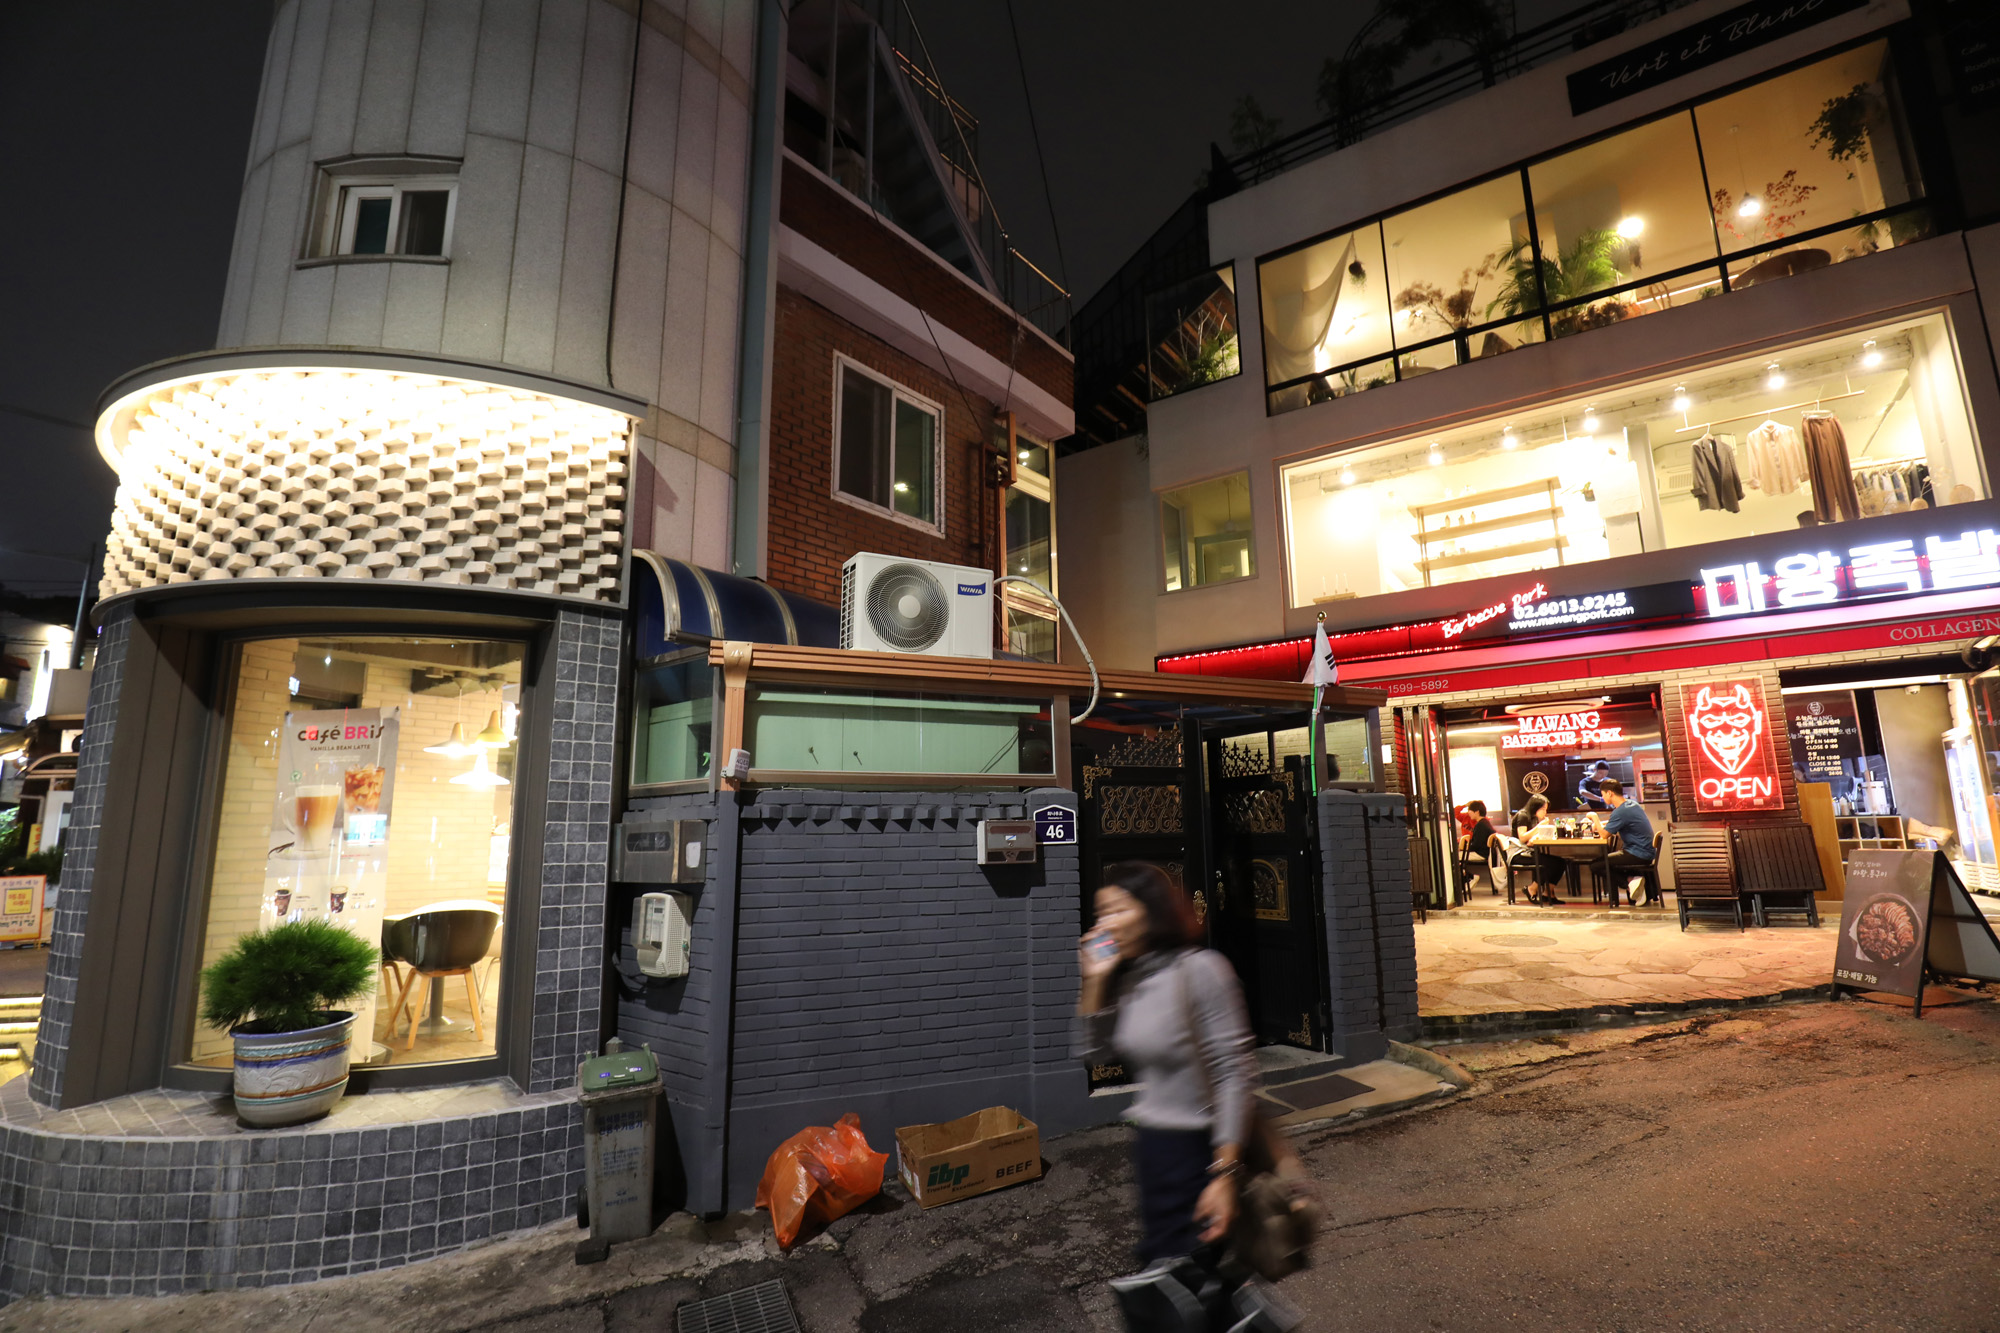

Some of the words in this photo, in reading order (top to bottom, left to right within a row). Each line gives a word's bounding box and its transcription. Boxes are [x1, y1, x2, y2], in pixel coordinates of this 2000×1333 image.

[1600, 50, 1670, 89] Vert
[1680, 34, 1712, 62] et
[1700, 528, 2000, 618] 마왕족발
[960, 586, 983, 595] WINIA
[1441, 601, 1507, 639] Barbecue
[1511, 582, 1548, 612] Pork
[1508, 604, 1635, 631] www.mawangpork.com
[1513, 592, 1627, 620] 02.6013.9245
[1889, 617, 2000, 642] COLLAGEN
[1388, 679, 1449, 694] 1599-5892
[1517, 711, 1601, 734] MAWANG
[297, 726, 341, 744] café
[1501, 731, 1578, 749] BARBECUE
[1580, 727, 1624, 745] PORK
[1699, 775, 1772, 799] OPEN
[1046, 824, 1064, 839] 46
[1864, 973, 1878, 984] 가능
[927, 1162, 970, 1187] ibp
[995, 1160, 1033, 1179] BEEF
[926, 1184, 951, 1194] Trusted
[951, 1179, 985, 1193] Excellence
